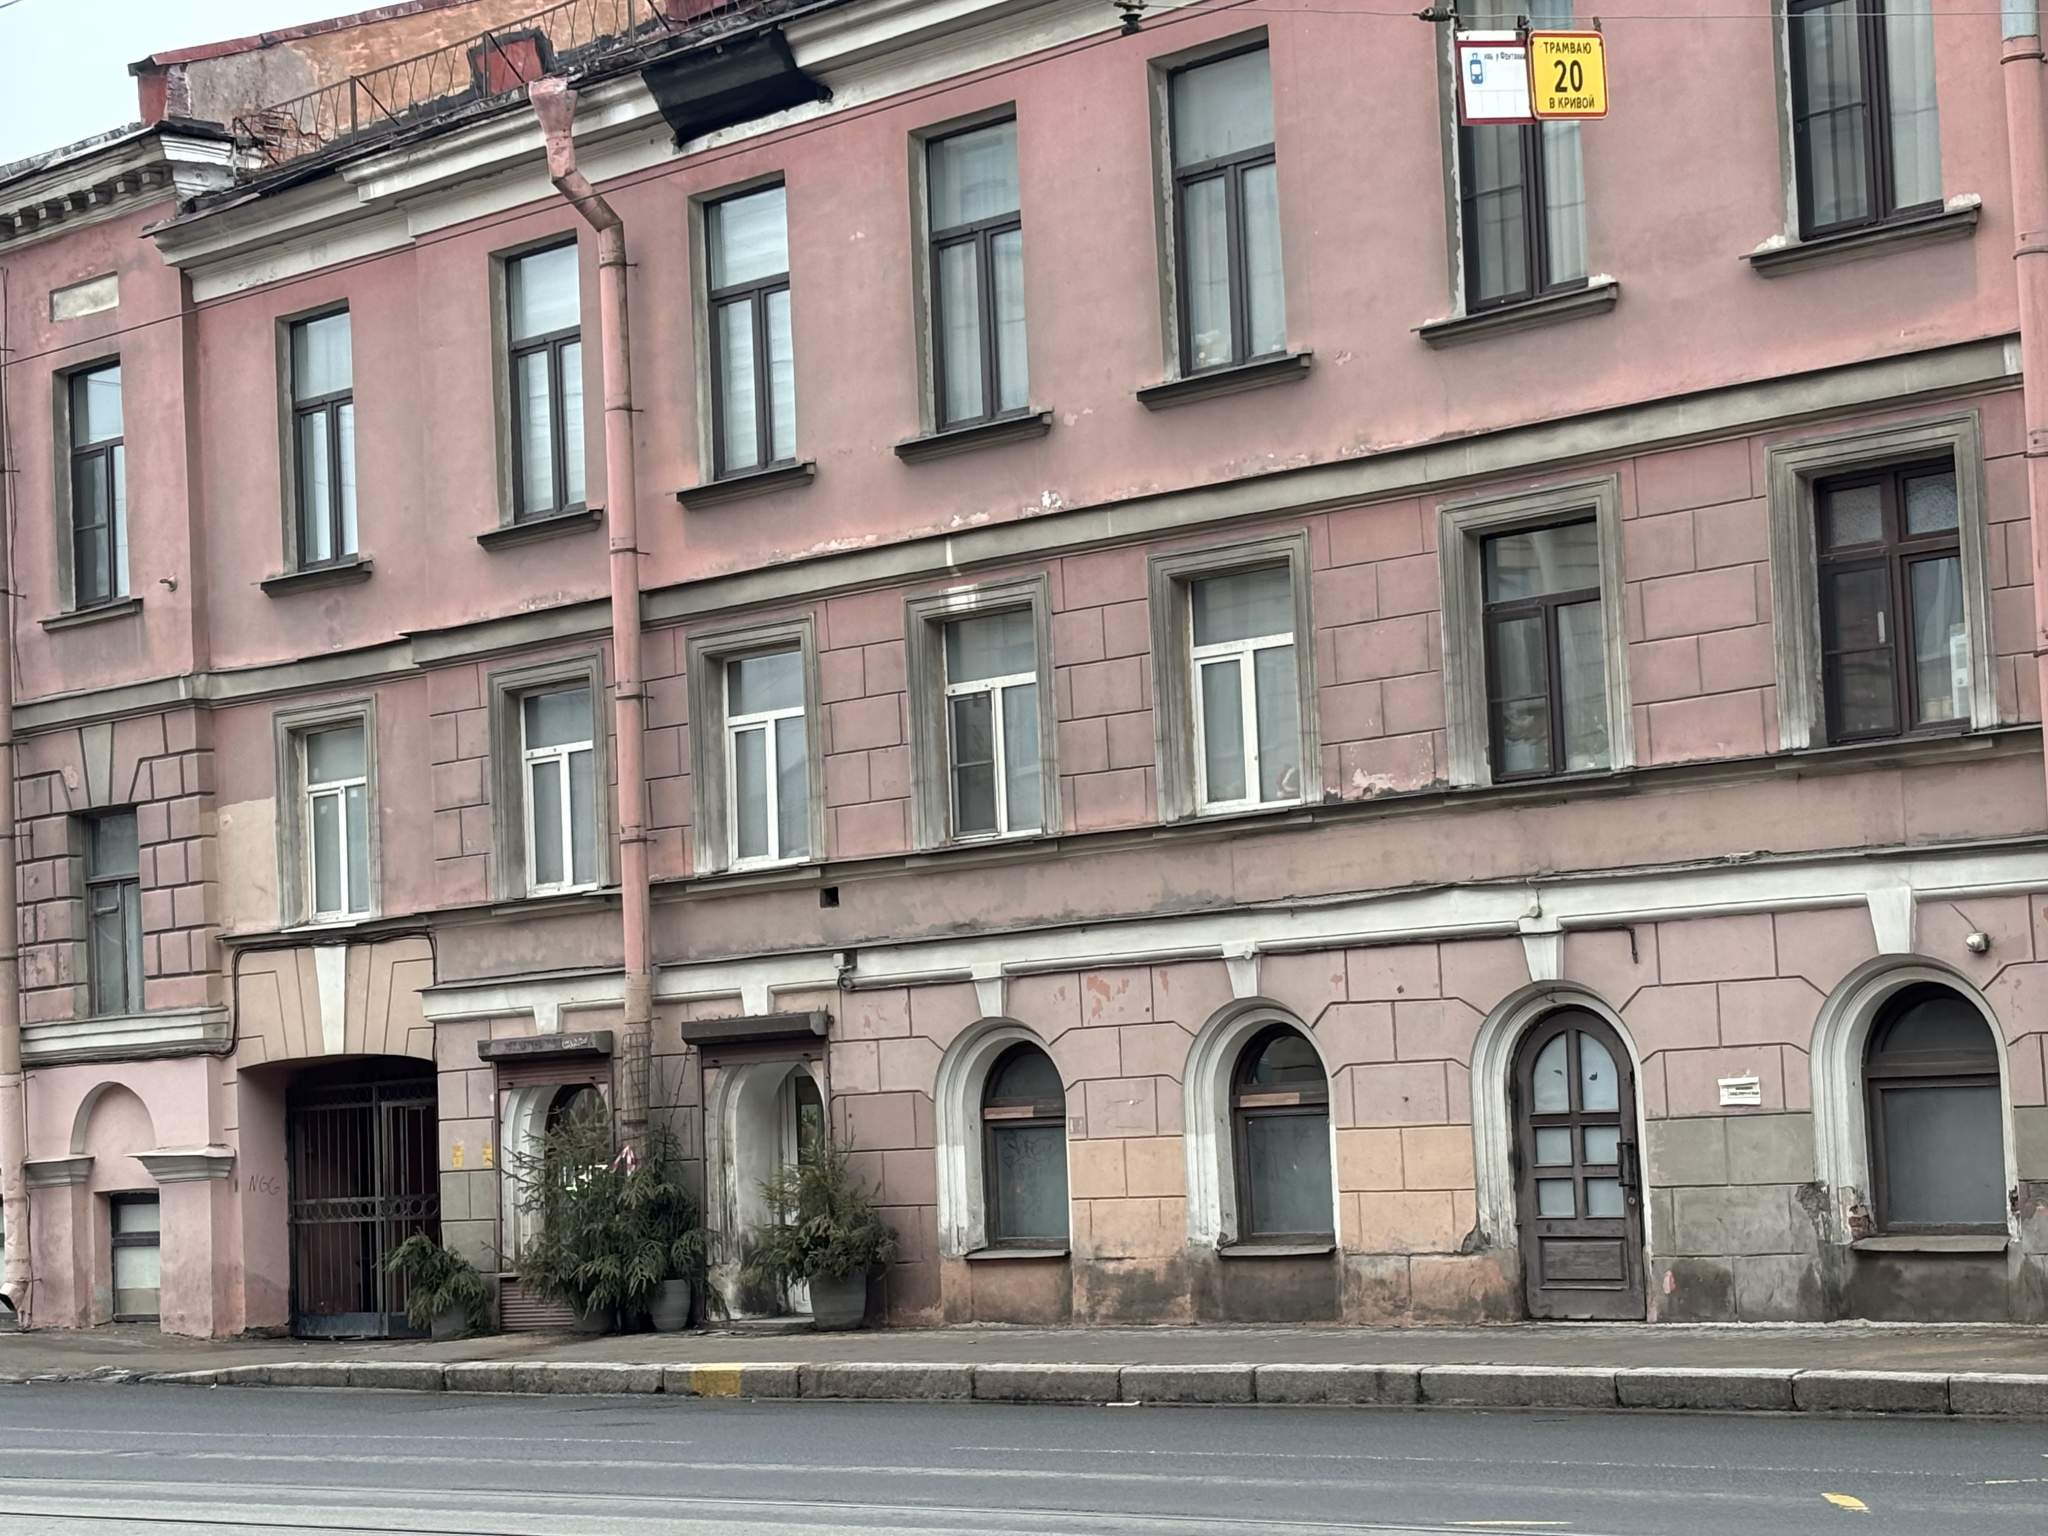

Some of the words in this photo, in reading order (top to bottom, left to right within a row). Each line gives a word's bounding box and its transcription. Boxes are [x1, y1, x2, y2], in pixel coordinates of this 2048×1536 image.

[1543, 42, 1592, 54] ТРАМВАЮ
[1553, 59, 1583, 93] 20
[1549, 97, 1556, 109] В
[1558, 95, 1595, 109] КРИВОЙ
